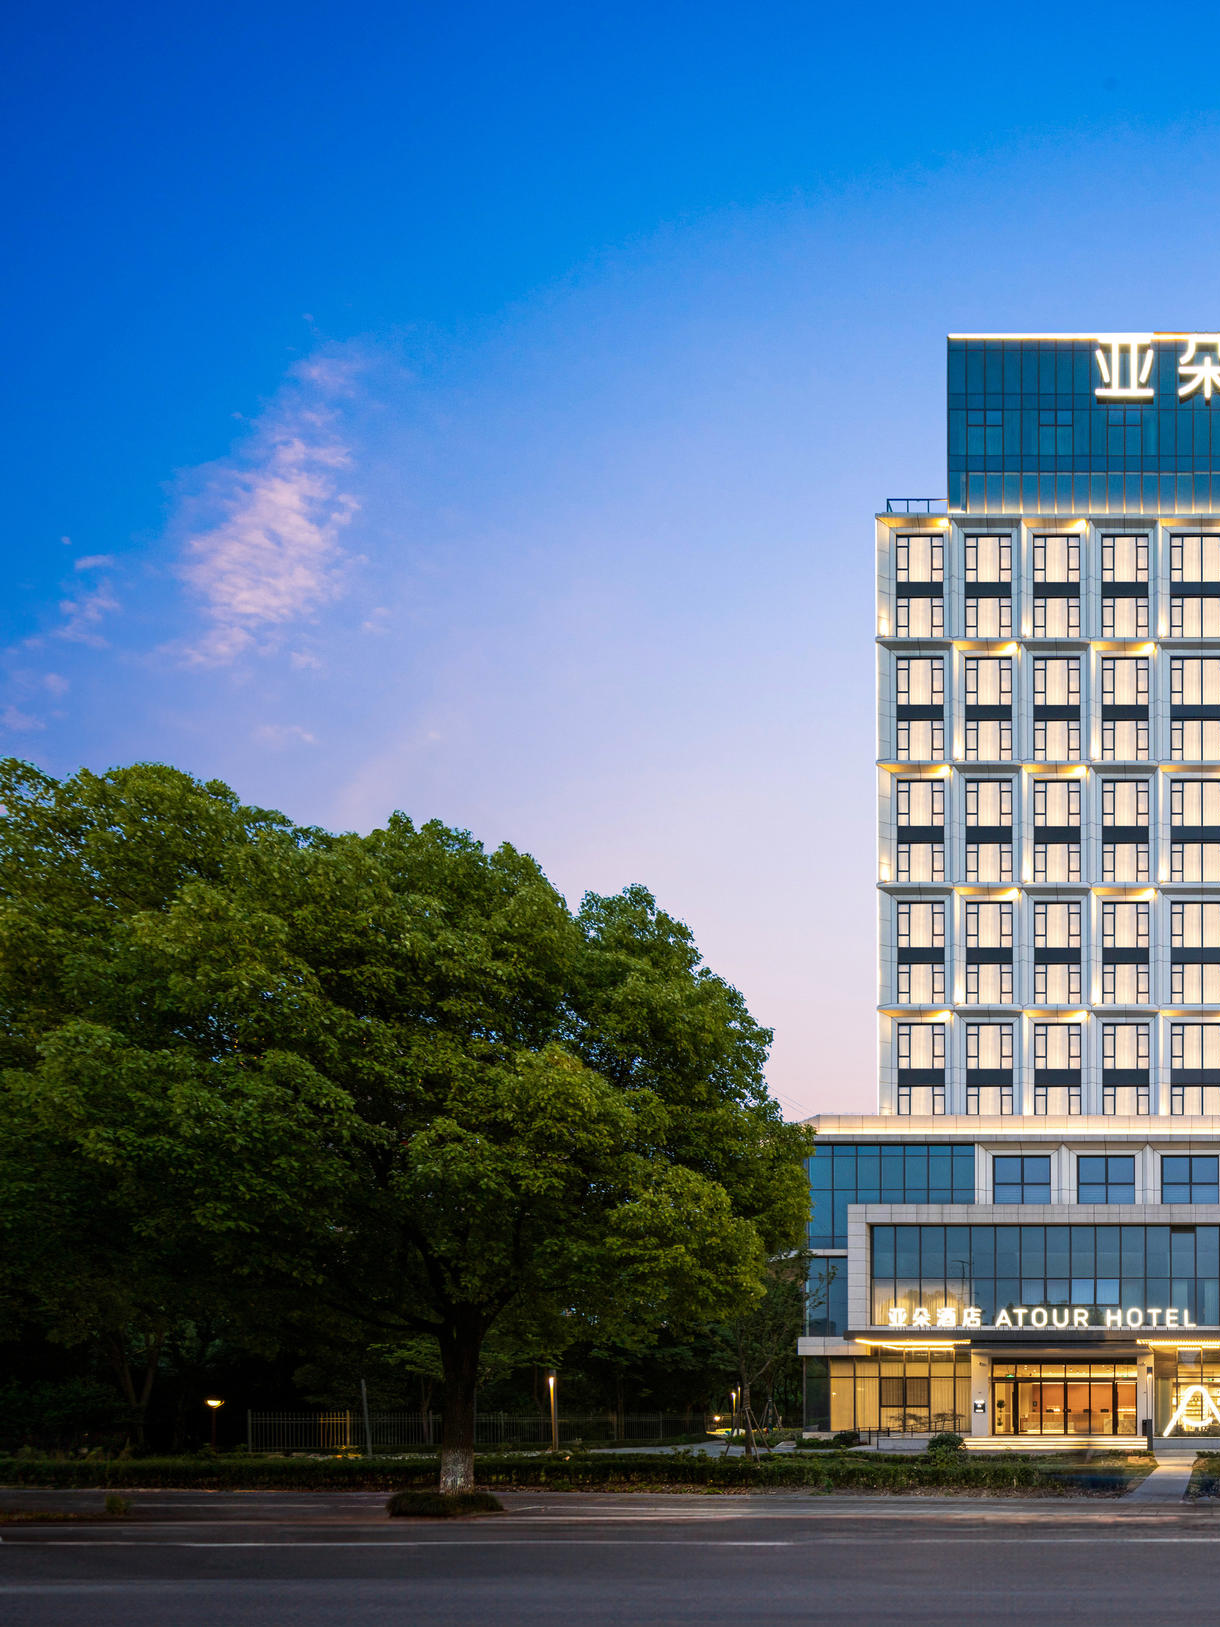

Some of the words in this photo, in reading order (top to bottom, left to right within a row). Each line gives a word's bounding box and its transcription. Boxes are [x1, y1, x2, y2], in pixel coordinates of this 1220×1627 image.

[888, 1307, 982, 1328] 亚朵酒店
[995, 1307, 1089, 1328] ATOUR
[1105, 1307, 1197, 1328] HOTEL
